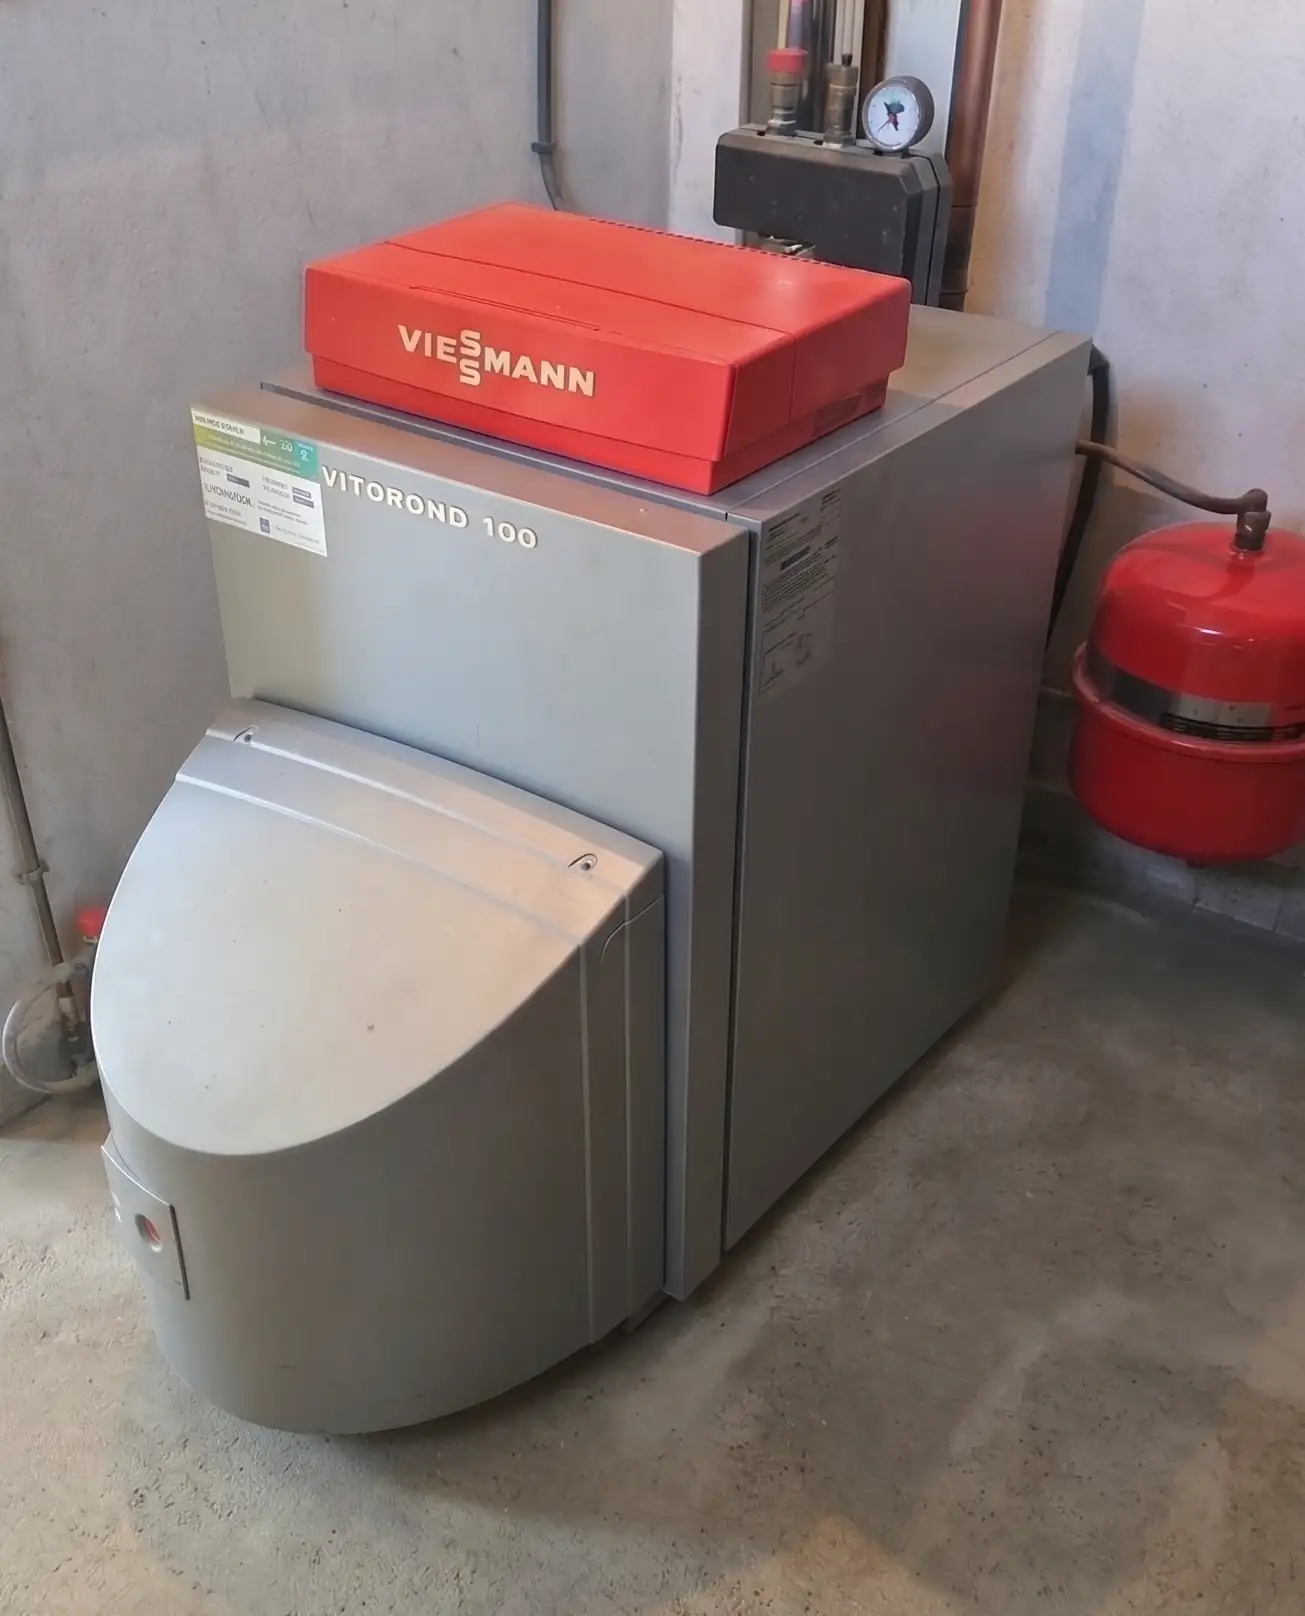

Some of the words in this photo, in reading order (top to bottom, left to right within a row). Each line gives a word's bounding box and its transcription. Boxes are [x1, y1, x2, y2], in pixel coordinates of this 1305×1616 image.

[398, 324, 595, 397] VIESSMANN
[321, 466, 469, 529] VITOROND
[483, 516, 538, 549] 100
